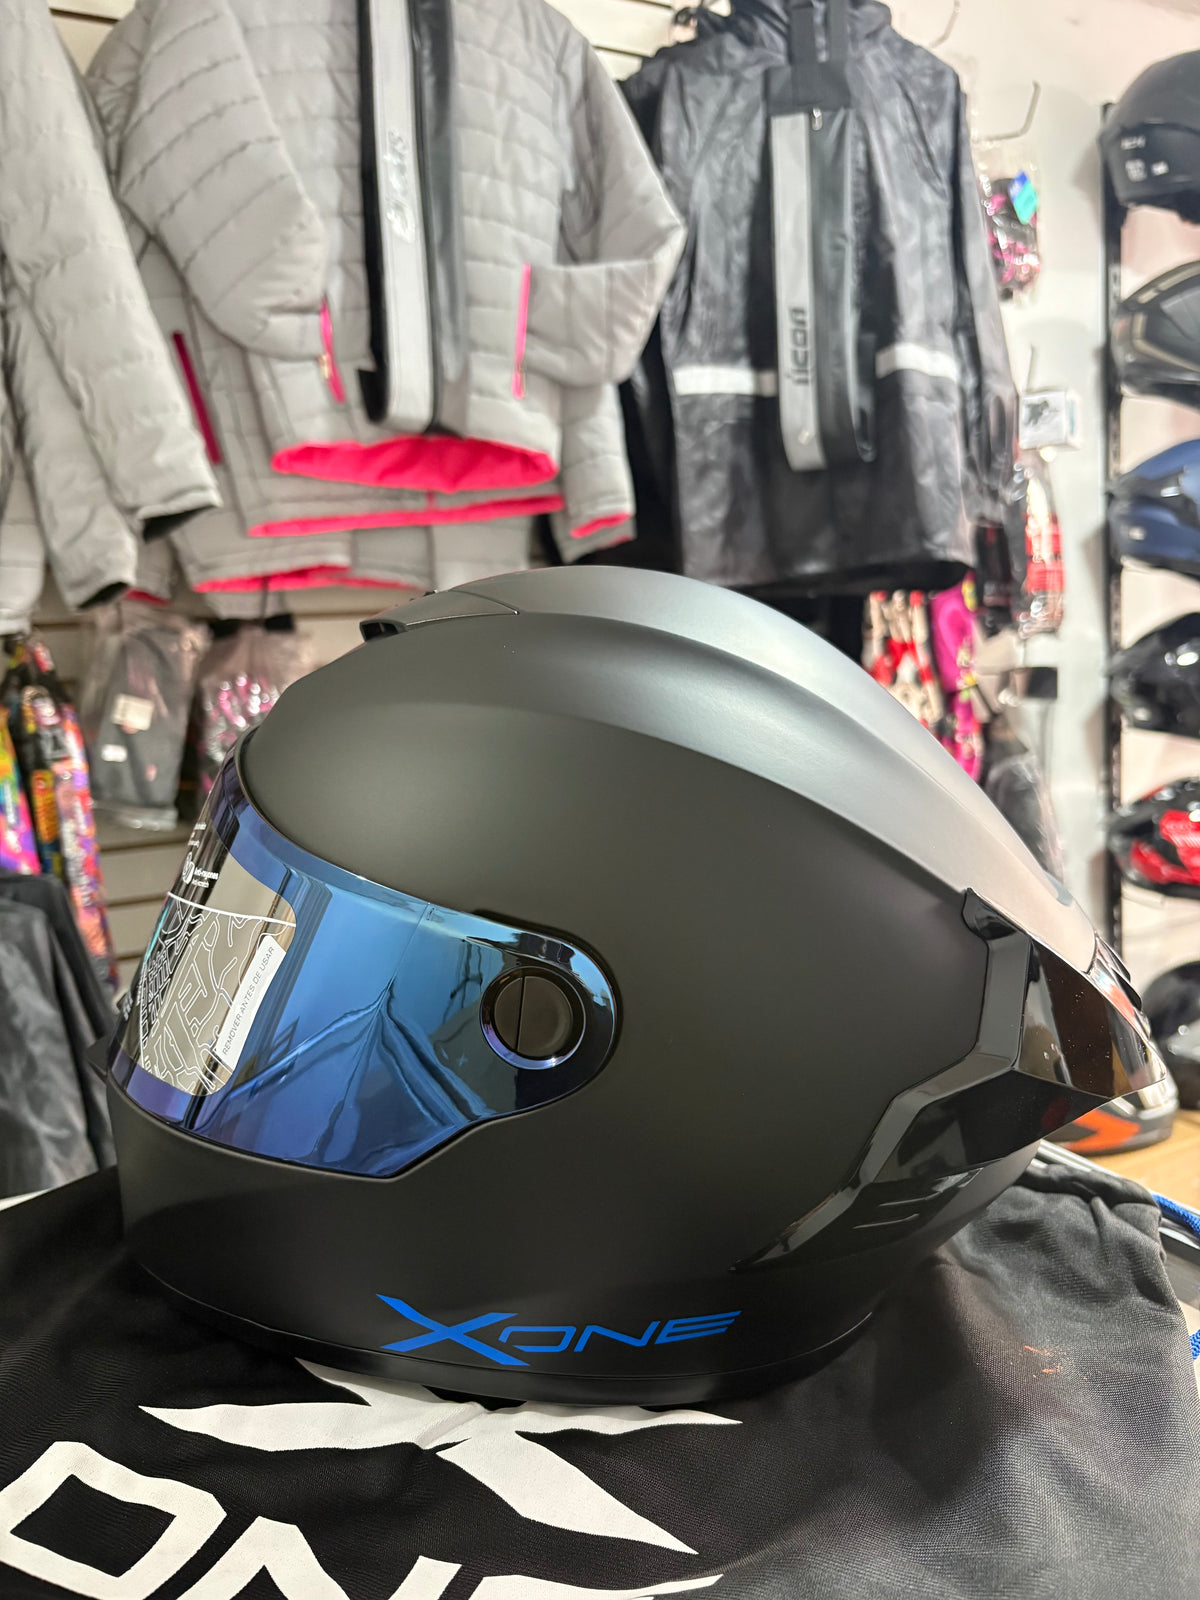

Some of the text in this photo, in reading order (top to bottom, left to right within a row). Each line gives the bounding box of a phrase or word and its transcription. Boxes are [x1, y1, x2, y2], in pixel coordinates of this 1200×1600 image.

[222, 946, 275, 1055] REMOVER ANTES DE USAR
